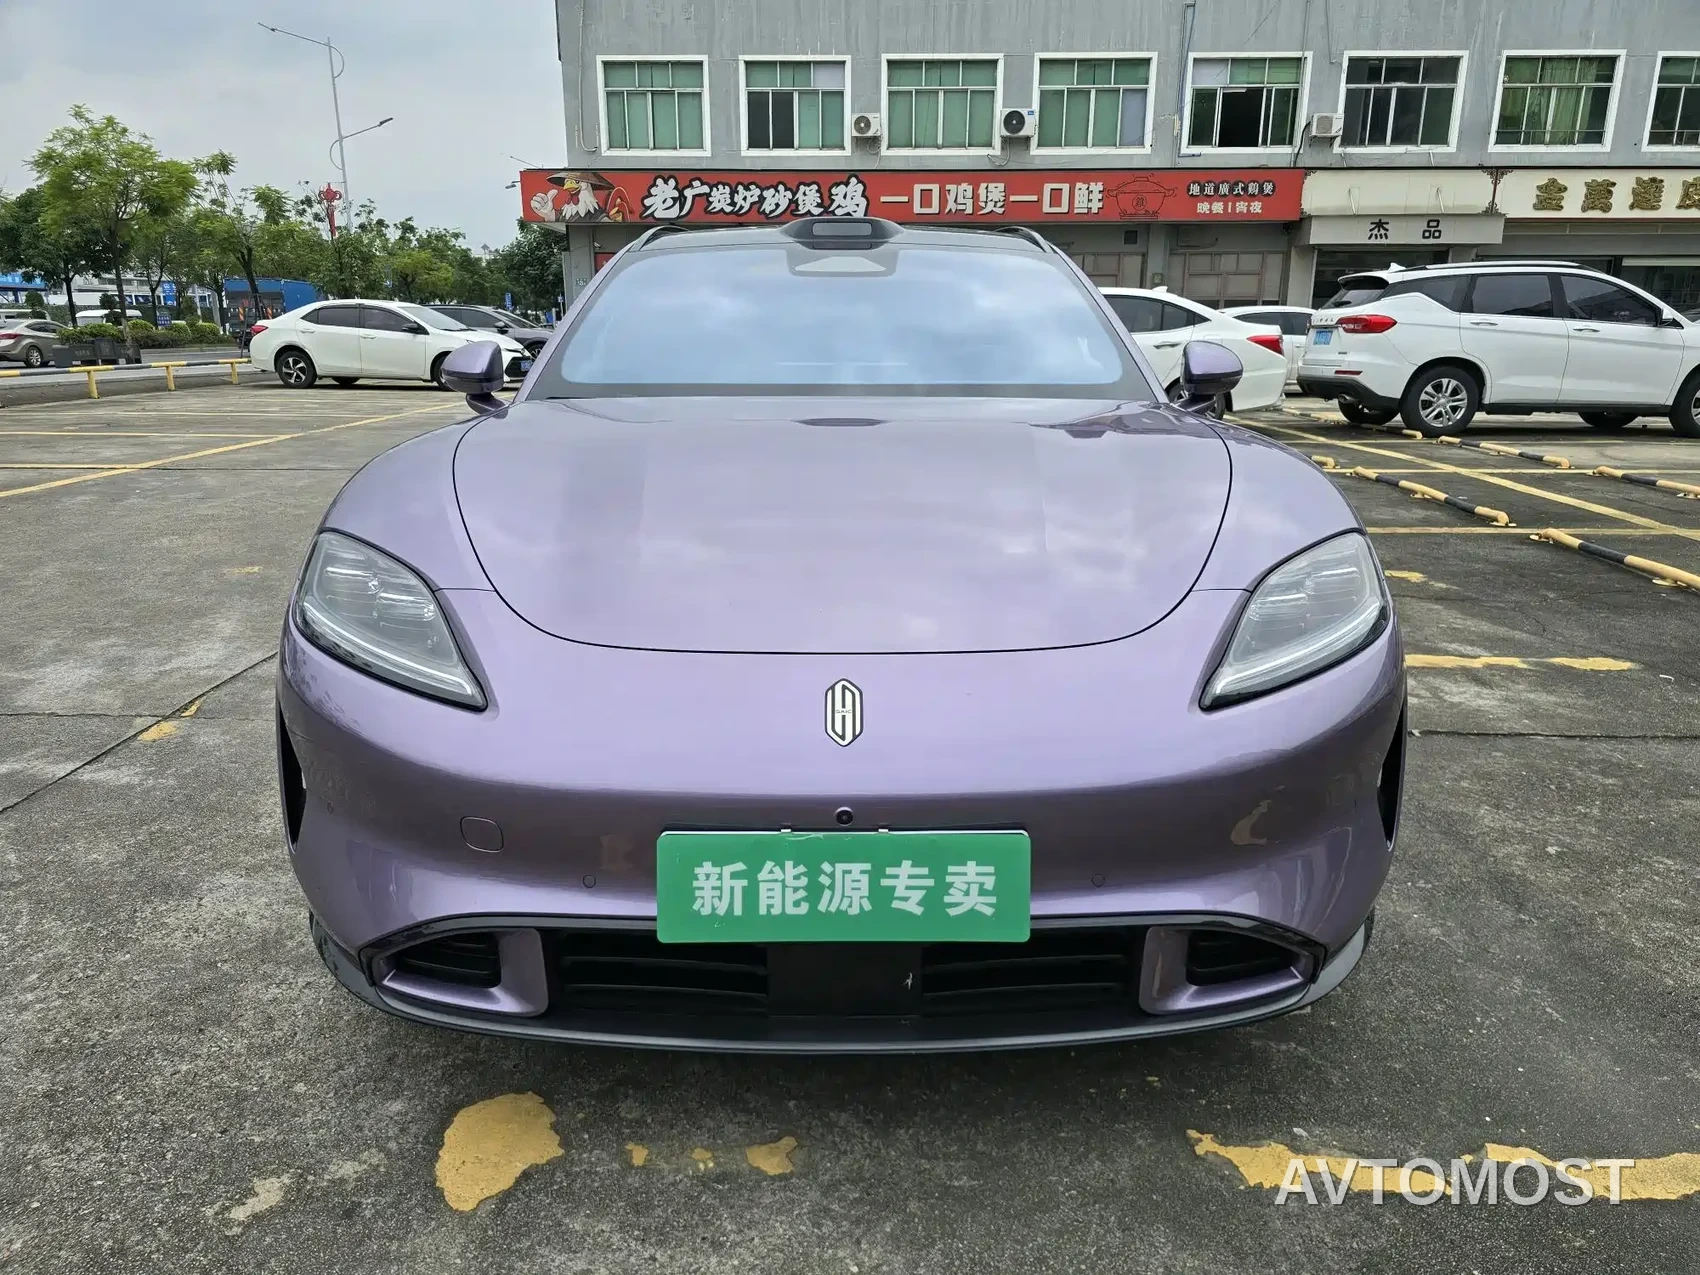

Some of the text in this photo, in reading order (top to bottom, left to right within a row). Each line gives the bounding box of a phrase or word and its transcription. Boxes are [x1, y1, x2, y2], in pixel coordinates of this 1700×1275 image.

[880, 182, 1104, 215] 一口鸡煲一口鲜
[1368, 219, 1442, 240] 杰品
[692, 860, 997, 917] 新能源专卖
